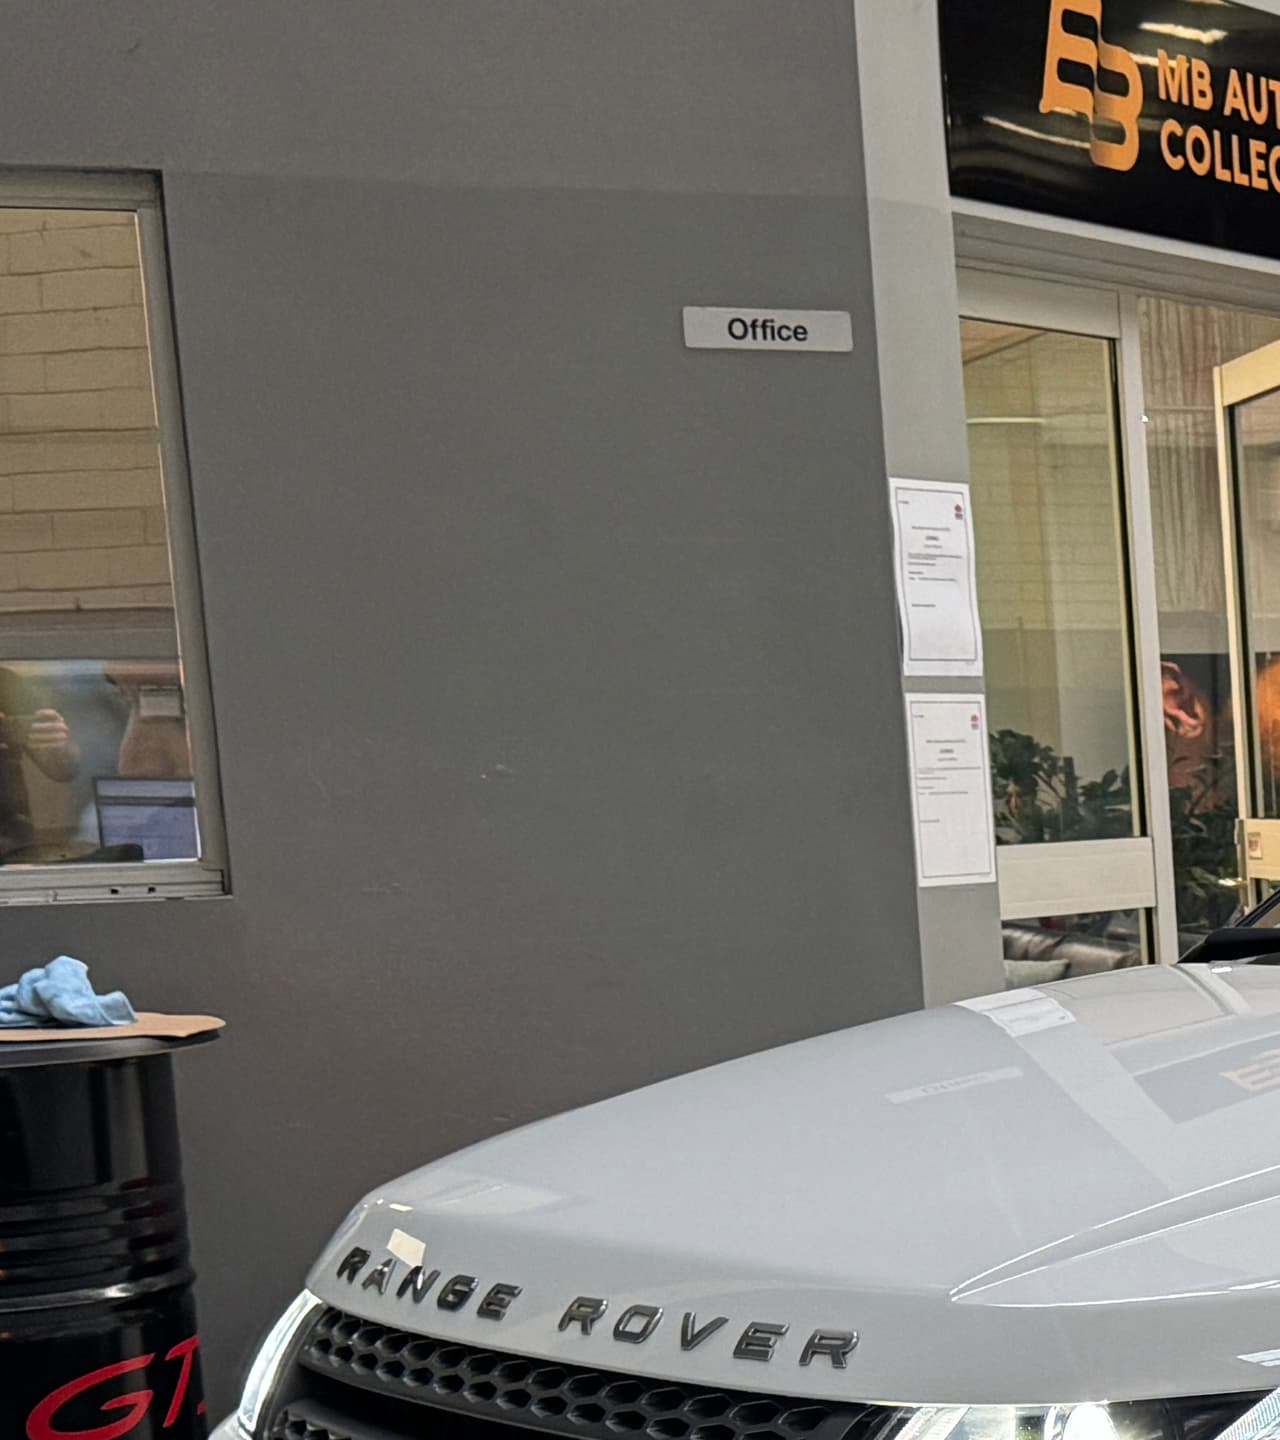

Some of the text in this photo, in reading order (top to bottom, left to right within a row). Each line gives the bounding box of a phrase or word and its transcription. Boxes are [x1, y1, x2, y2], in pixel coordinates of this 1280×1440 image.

[1157, 48, 1214, 112] MB
[727, 317, 808, 342] Office
[336, 1246, 859, 1369] RANGE ROVER
